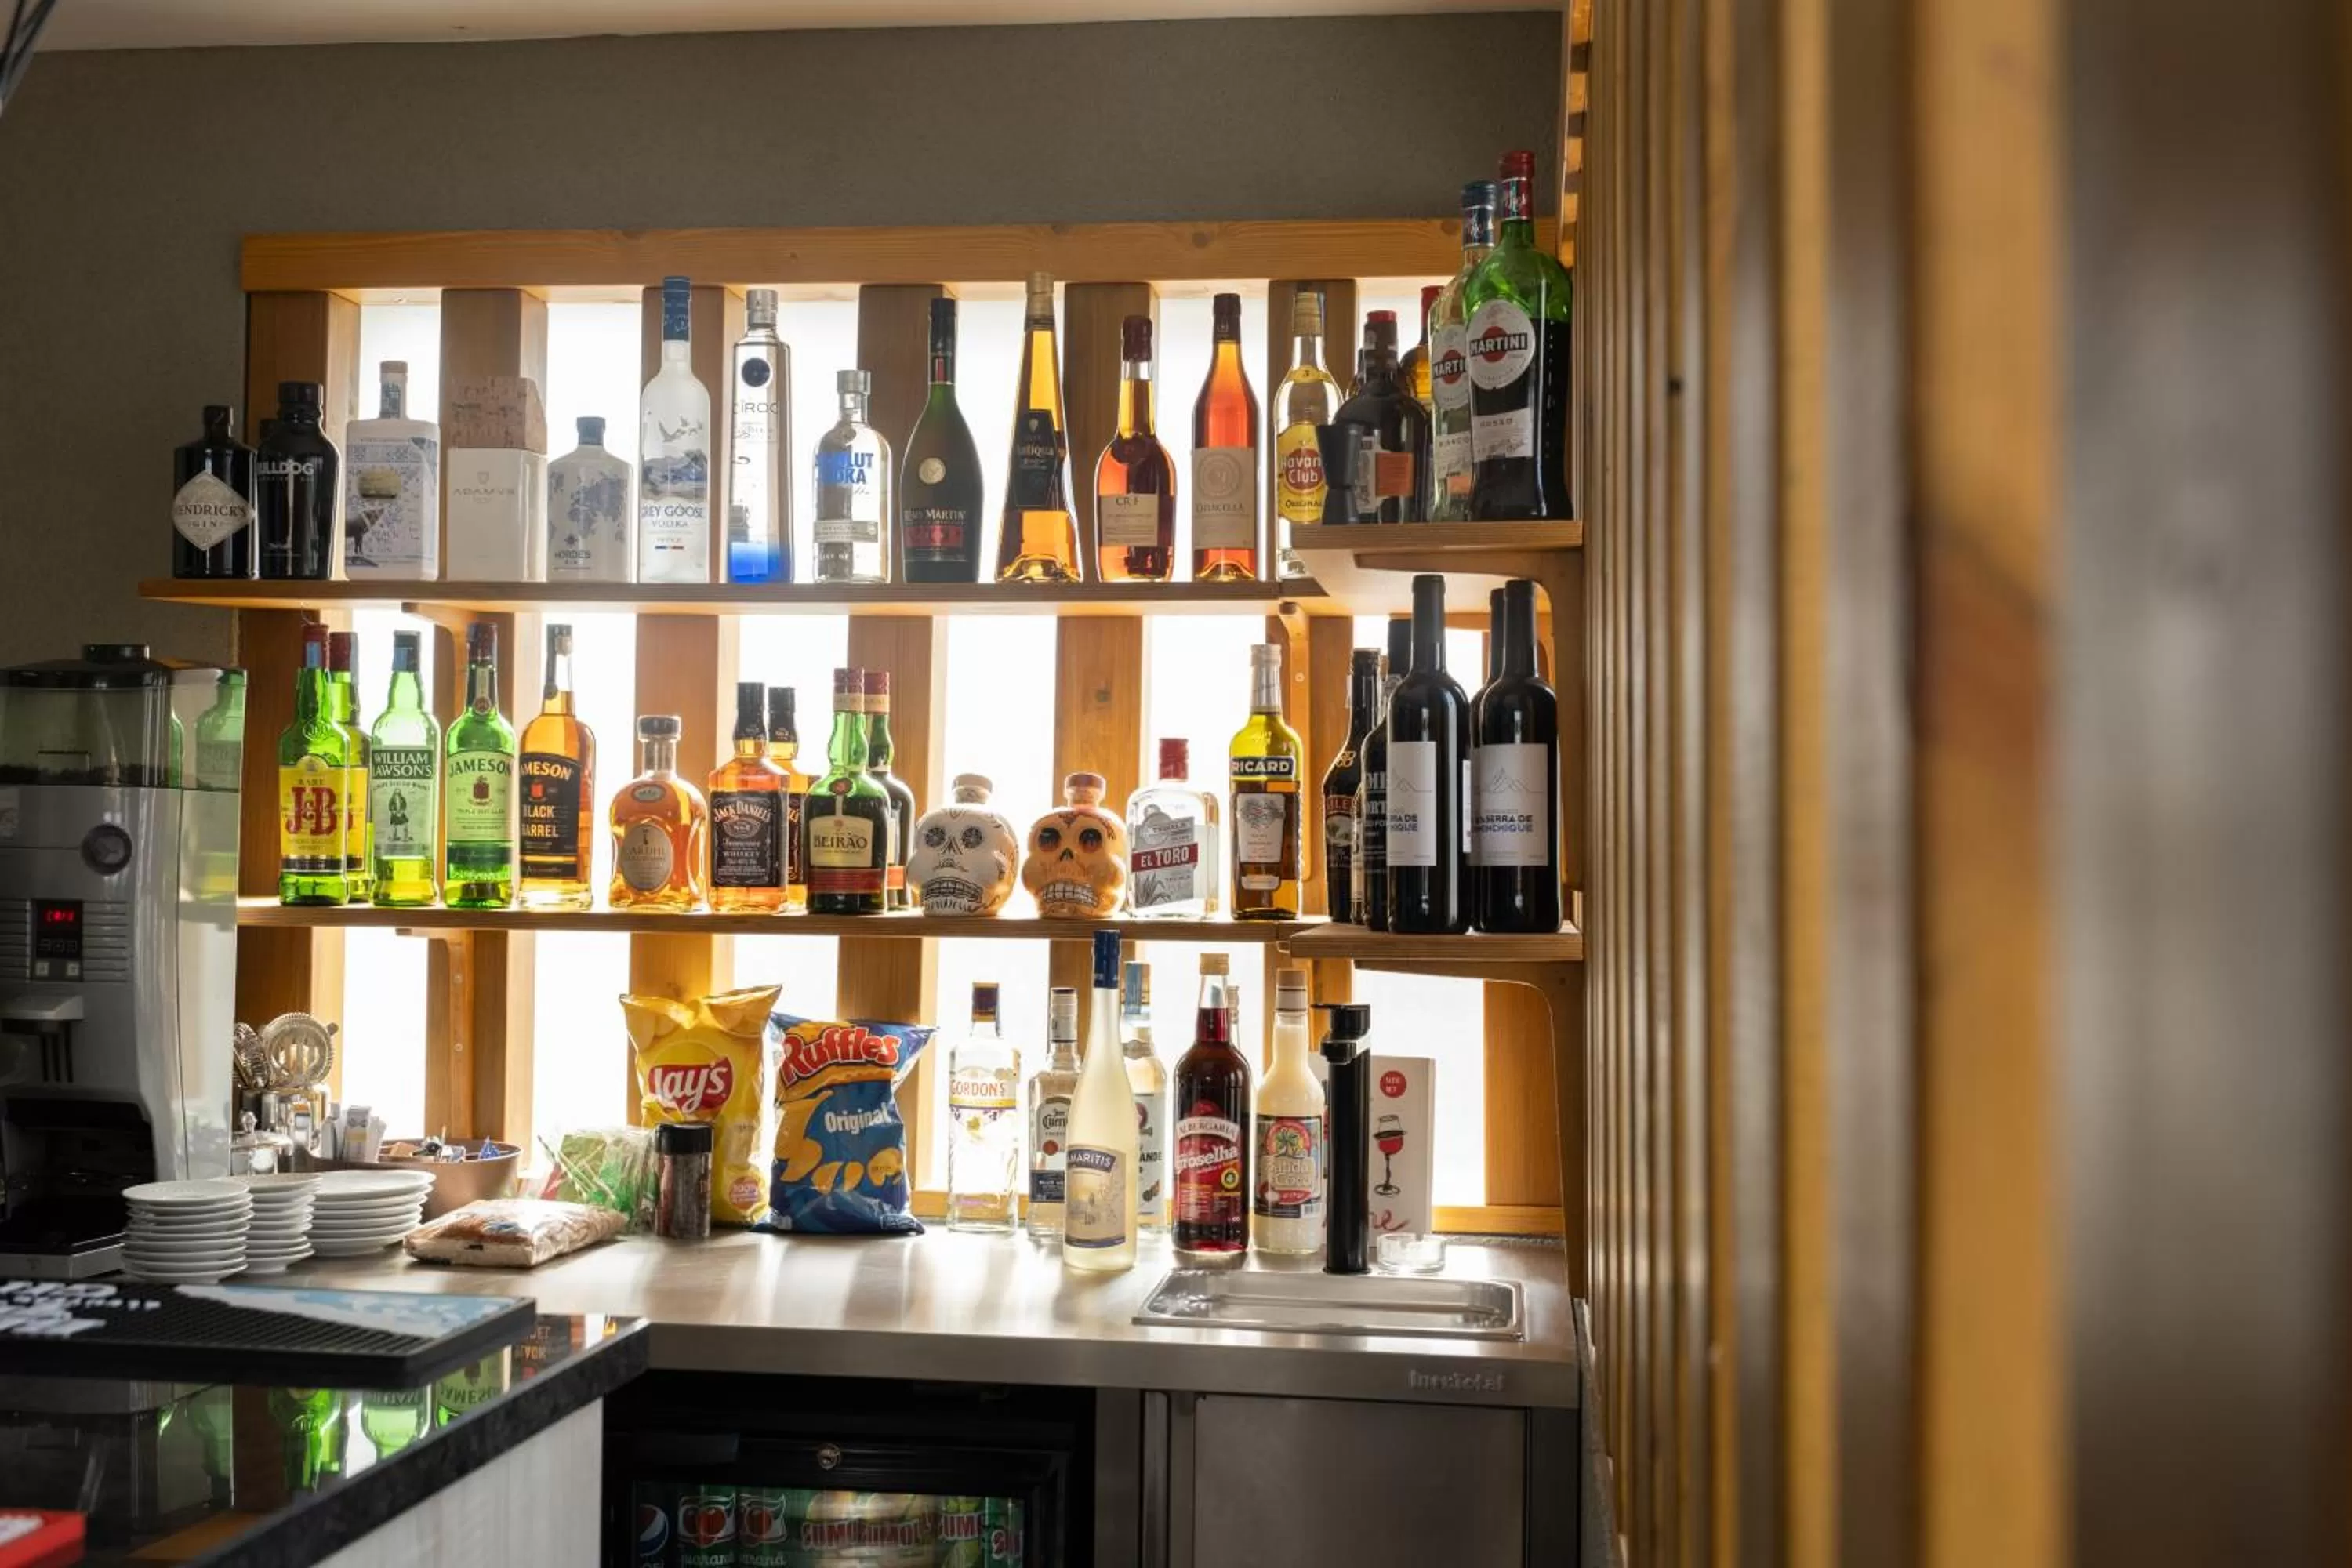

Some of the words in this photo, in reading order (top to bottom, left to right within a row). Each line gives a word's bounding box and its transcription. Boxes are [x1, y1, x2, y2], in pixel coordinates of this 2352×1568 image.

[1470, 333, 1527, 356] MARTINI
[1433, 358, 1466, 378] MARTI
[1280, 457, 1321, 468] Havan
[1288, 470, 1319, 483] Club
[373, 752, 428, 764] WILLIAM
[448, 758, 512, 778] JAMESON
[1231, 760, 1290, 773] RICARD
[285, 786, 338, 836] J&B
[1141, 855, 1152, 868] EL
[1156, 846, 1189, 866] TORO
[781, 1026, 902, 1087] Ruffles
[654, 1060, 728, 1114] Lay's
[824, 1102, 891, 1135] Original
[1042, 1115, 1068, 1130] Cuerv
